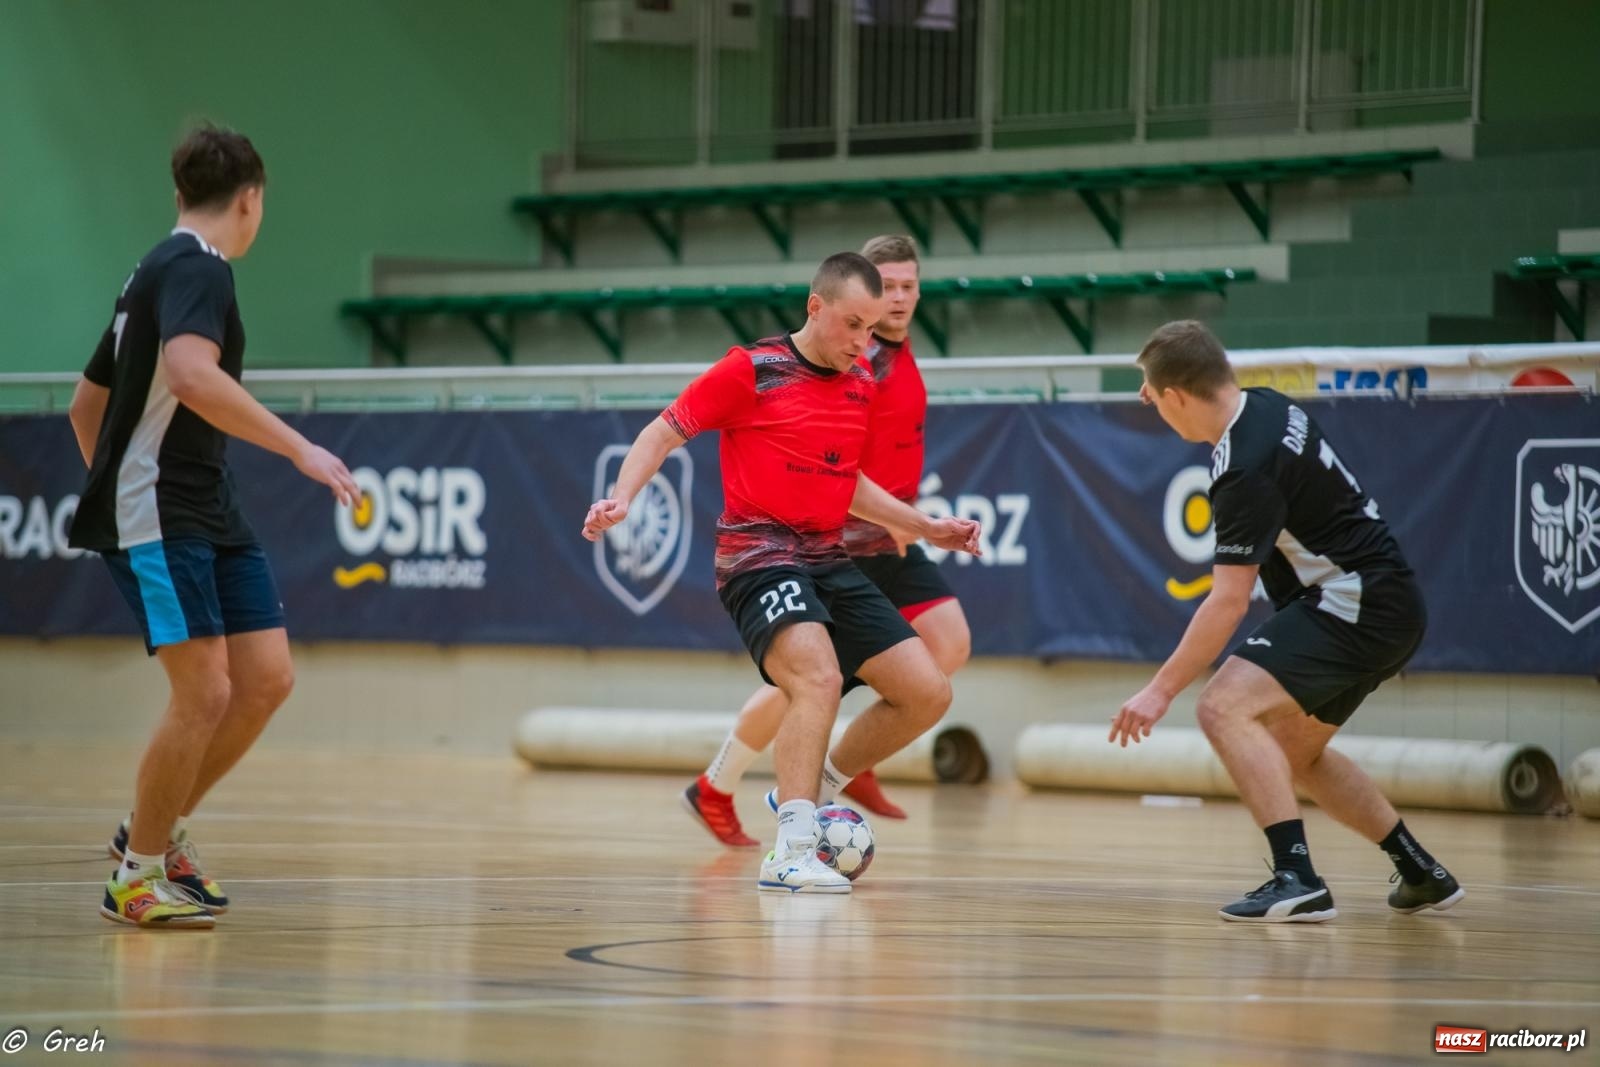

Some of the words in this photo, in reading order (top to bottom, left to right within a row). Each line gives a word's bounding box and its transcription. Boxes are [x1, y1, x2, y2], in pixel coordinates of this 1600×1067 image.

[0, 494, 100, 560] RAC
[335, 466, 487, 556] OSiR
[914, 472, 1030, 566] ÓRZ
[760, 581, 807, 623] 22
